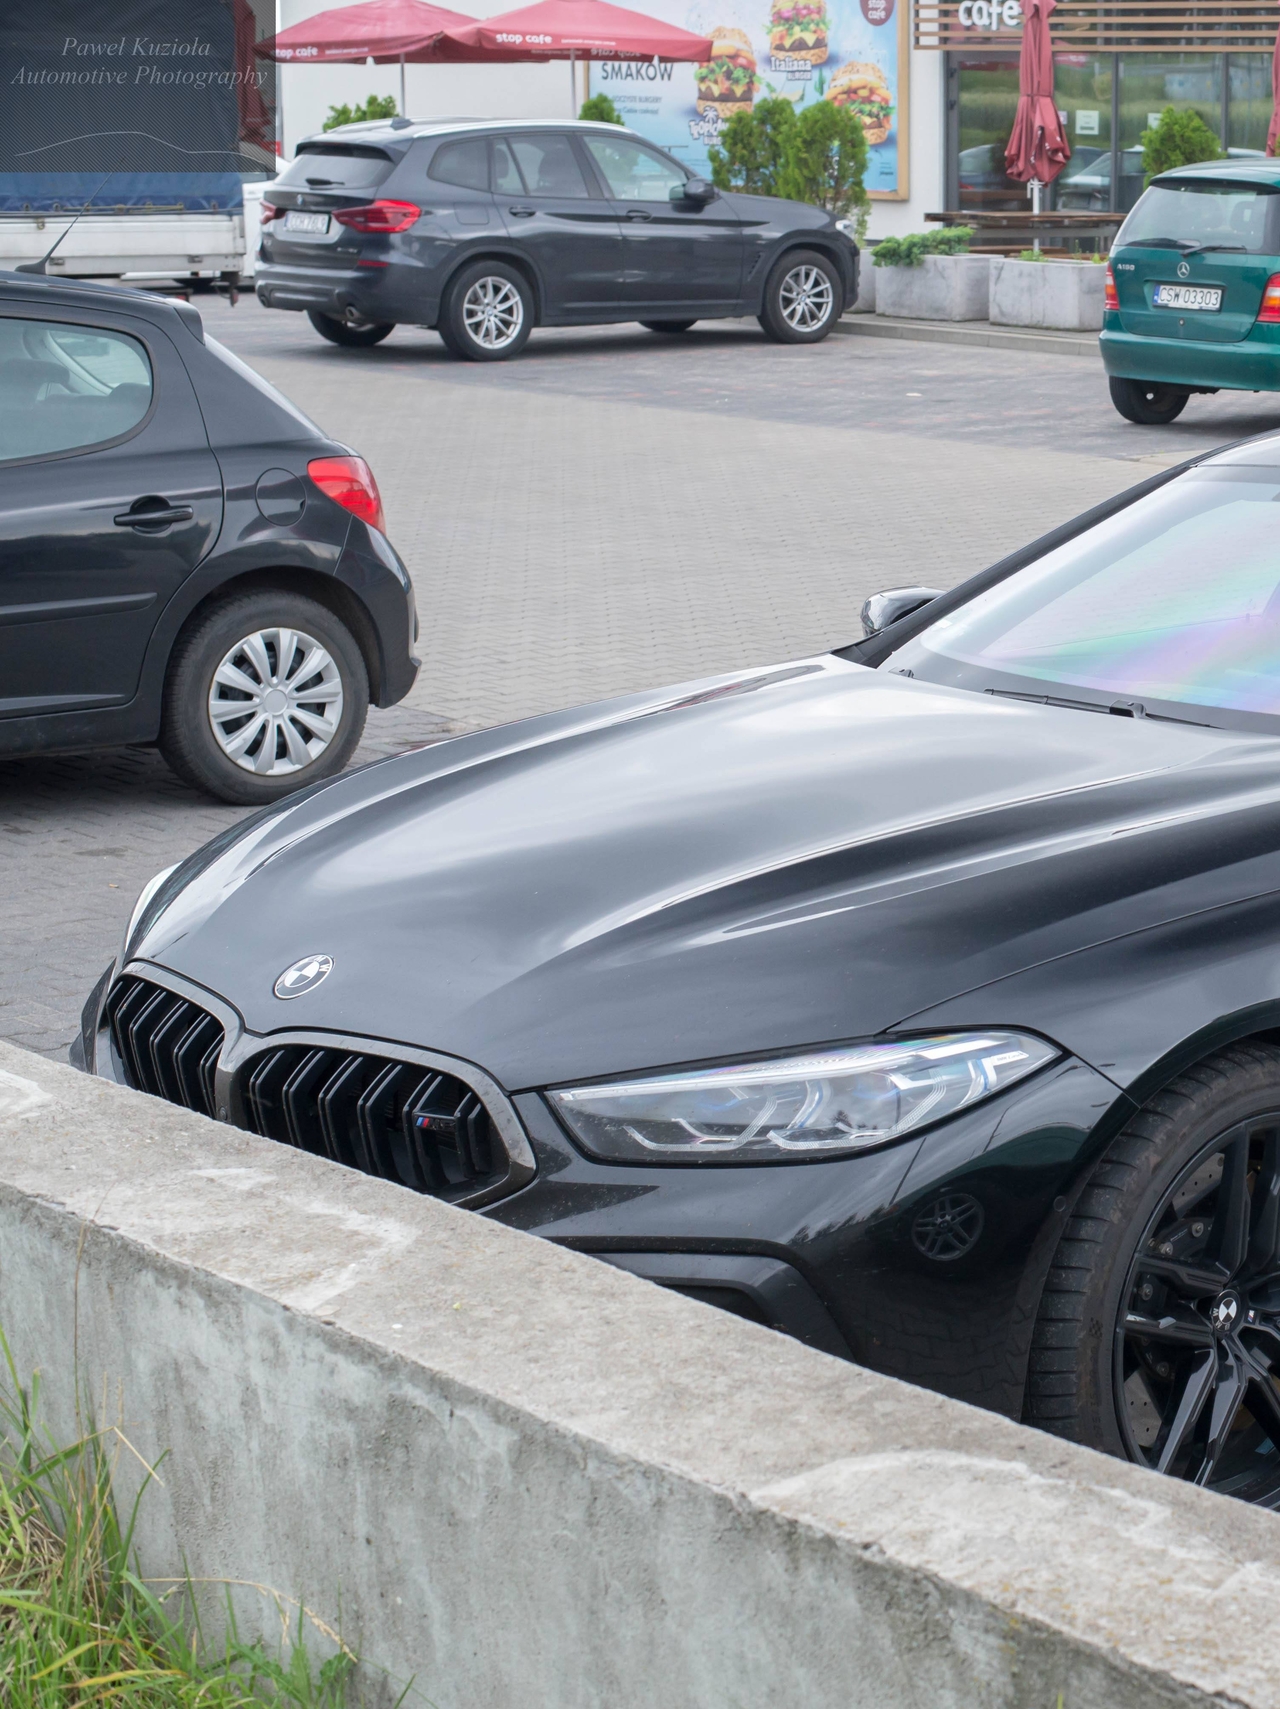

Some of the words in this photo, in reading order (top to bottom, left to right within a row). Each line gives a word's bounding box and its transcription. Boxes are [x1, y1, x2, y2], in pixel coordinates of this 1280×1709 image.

[958, 0, 1022, 31] cafe
[496, 33, 523, 45] stop
[525, 34, 552, 45] cafe
[275, 48, 294, 60] top
[296, 46, 318, 57] cafe
[1160, 287, 1180, 303] CSW
[1183, 289, 1219, 306] 03303
